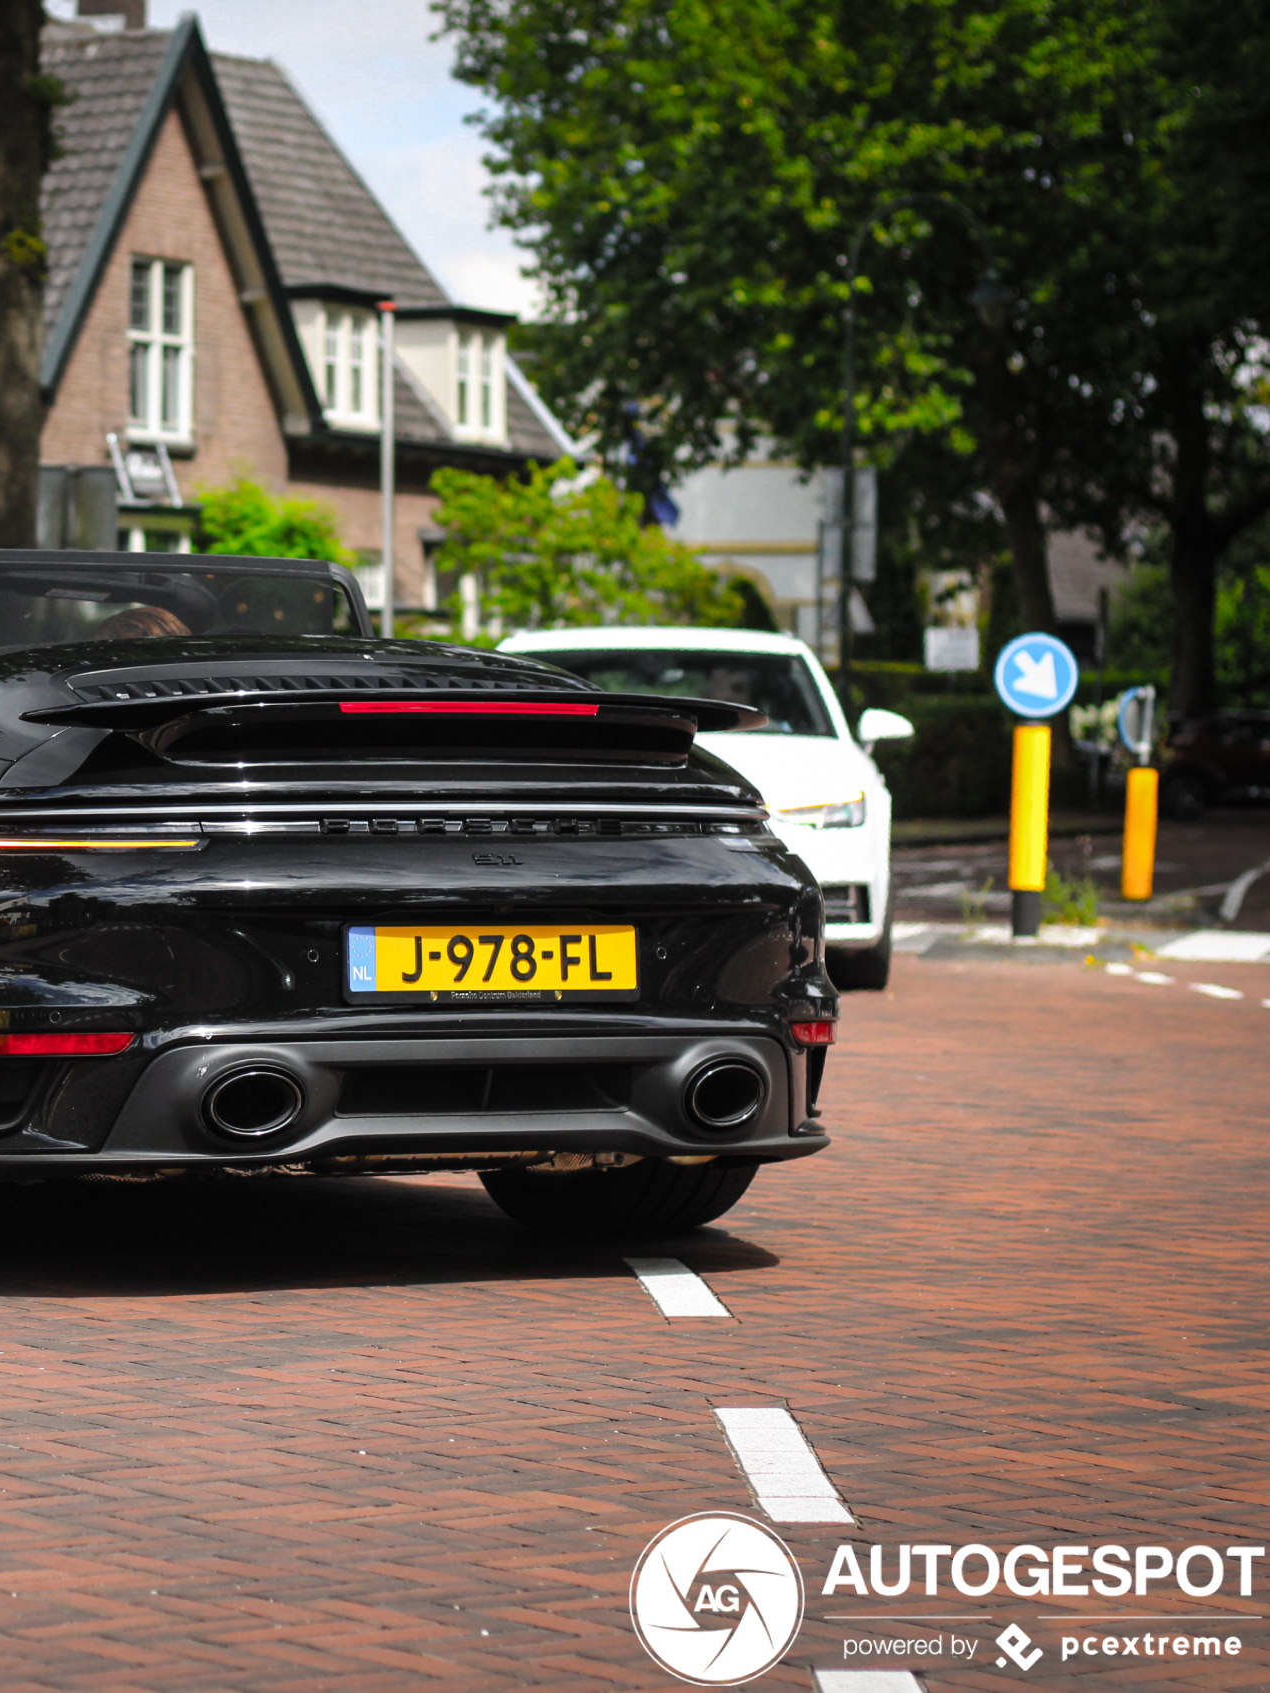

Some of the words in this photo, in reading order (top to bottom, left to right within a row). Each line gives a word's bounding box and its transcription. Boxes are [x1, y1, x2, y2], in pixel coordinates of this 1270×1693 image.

[318, 818, 622, 834] PORSCHE
[472, 853, 524, 865] 911
[402, 934, 612, 983] J-978-FL
[352, 966, 373, 980] NL
[451, 991, 477, 999] Porsche
[479, 991, 506, 999] Centrum
[507, 991, 542, 999] Gelderland
